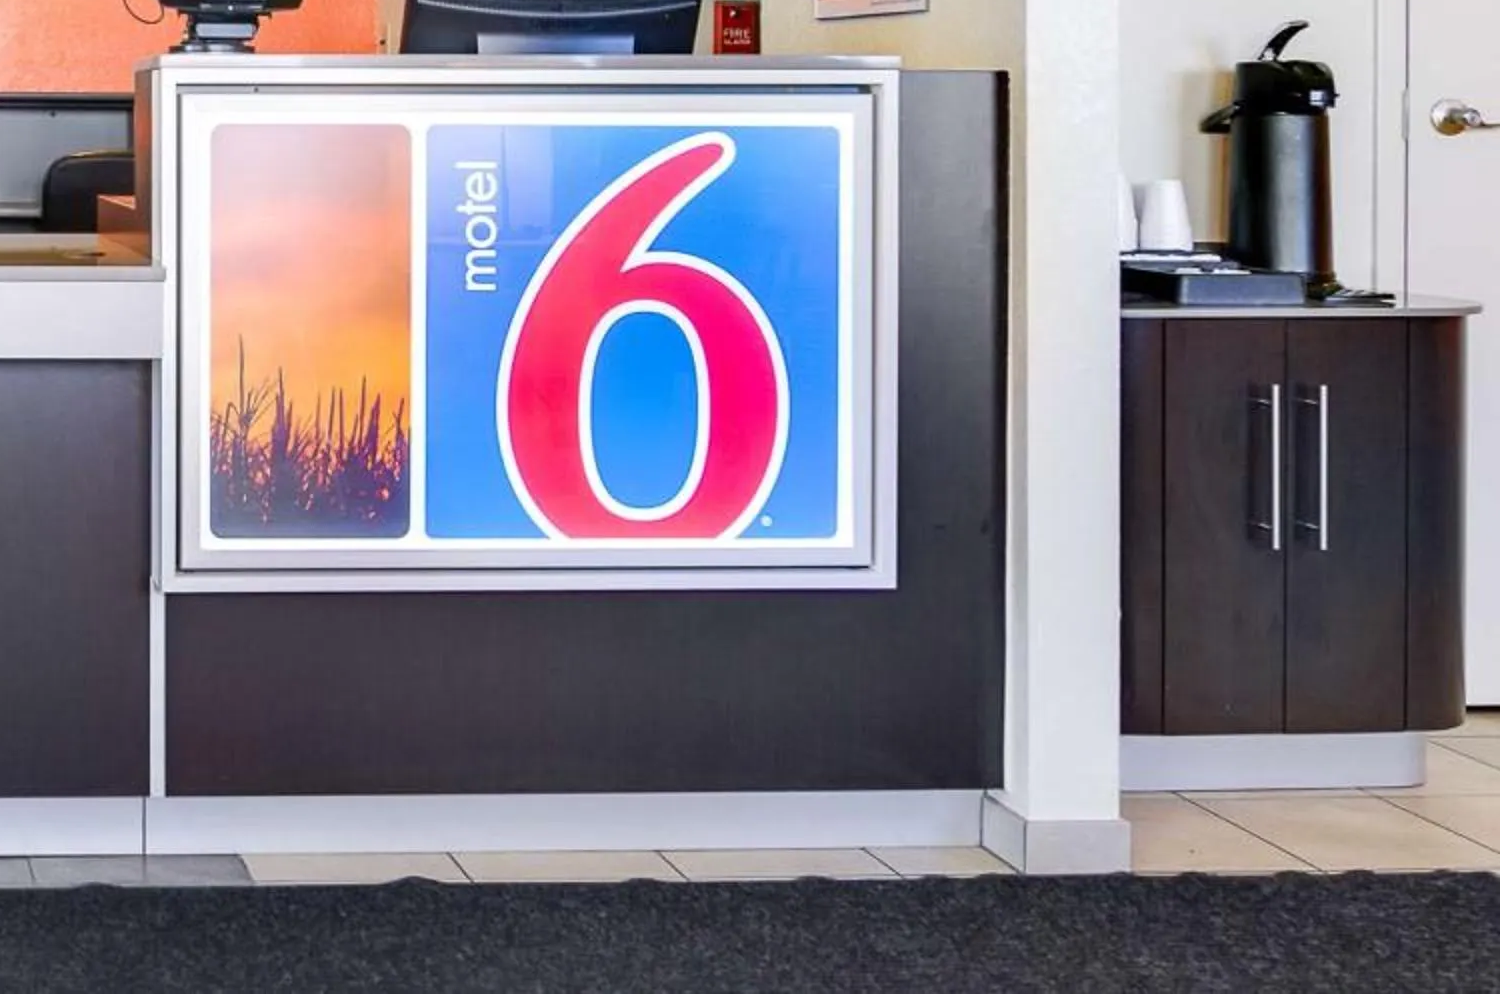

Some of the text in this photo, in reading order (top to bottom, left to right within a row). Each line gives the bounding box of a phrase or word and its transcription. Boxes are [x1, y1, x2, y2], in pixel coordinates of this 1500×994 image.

[723, 28, 751, 39] FIRE
[456, 161, 497, 292] motel
[496, 131, 791, 539] 6
